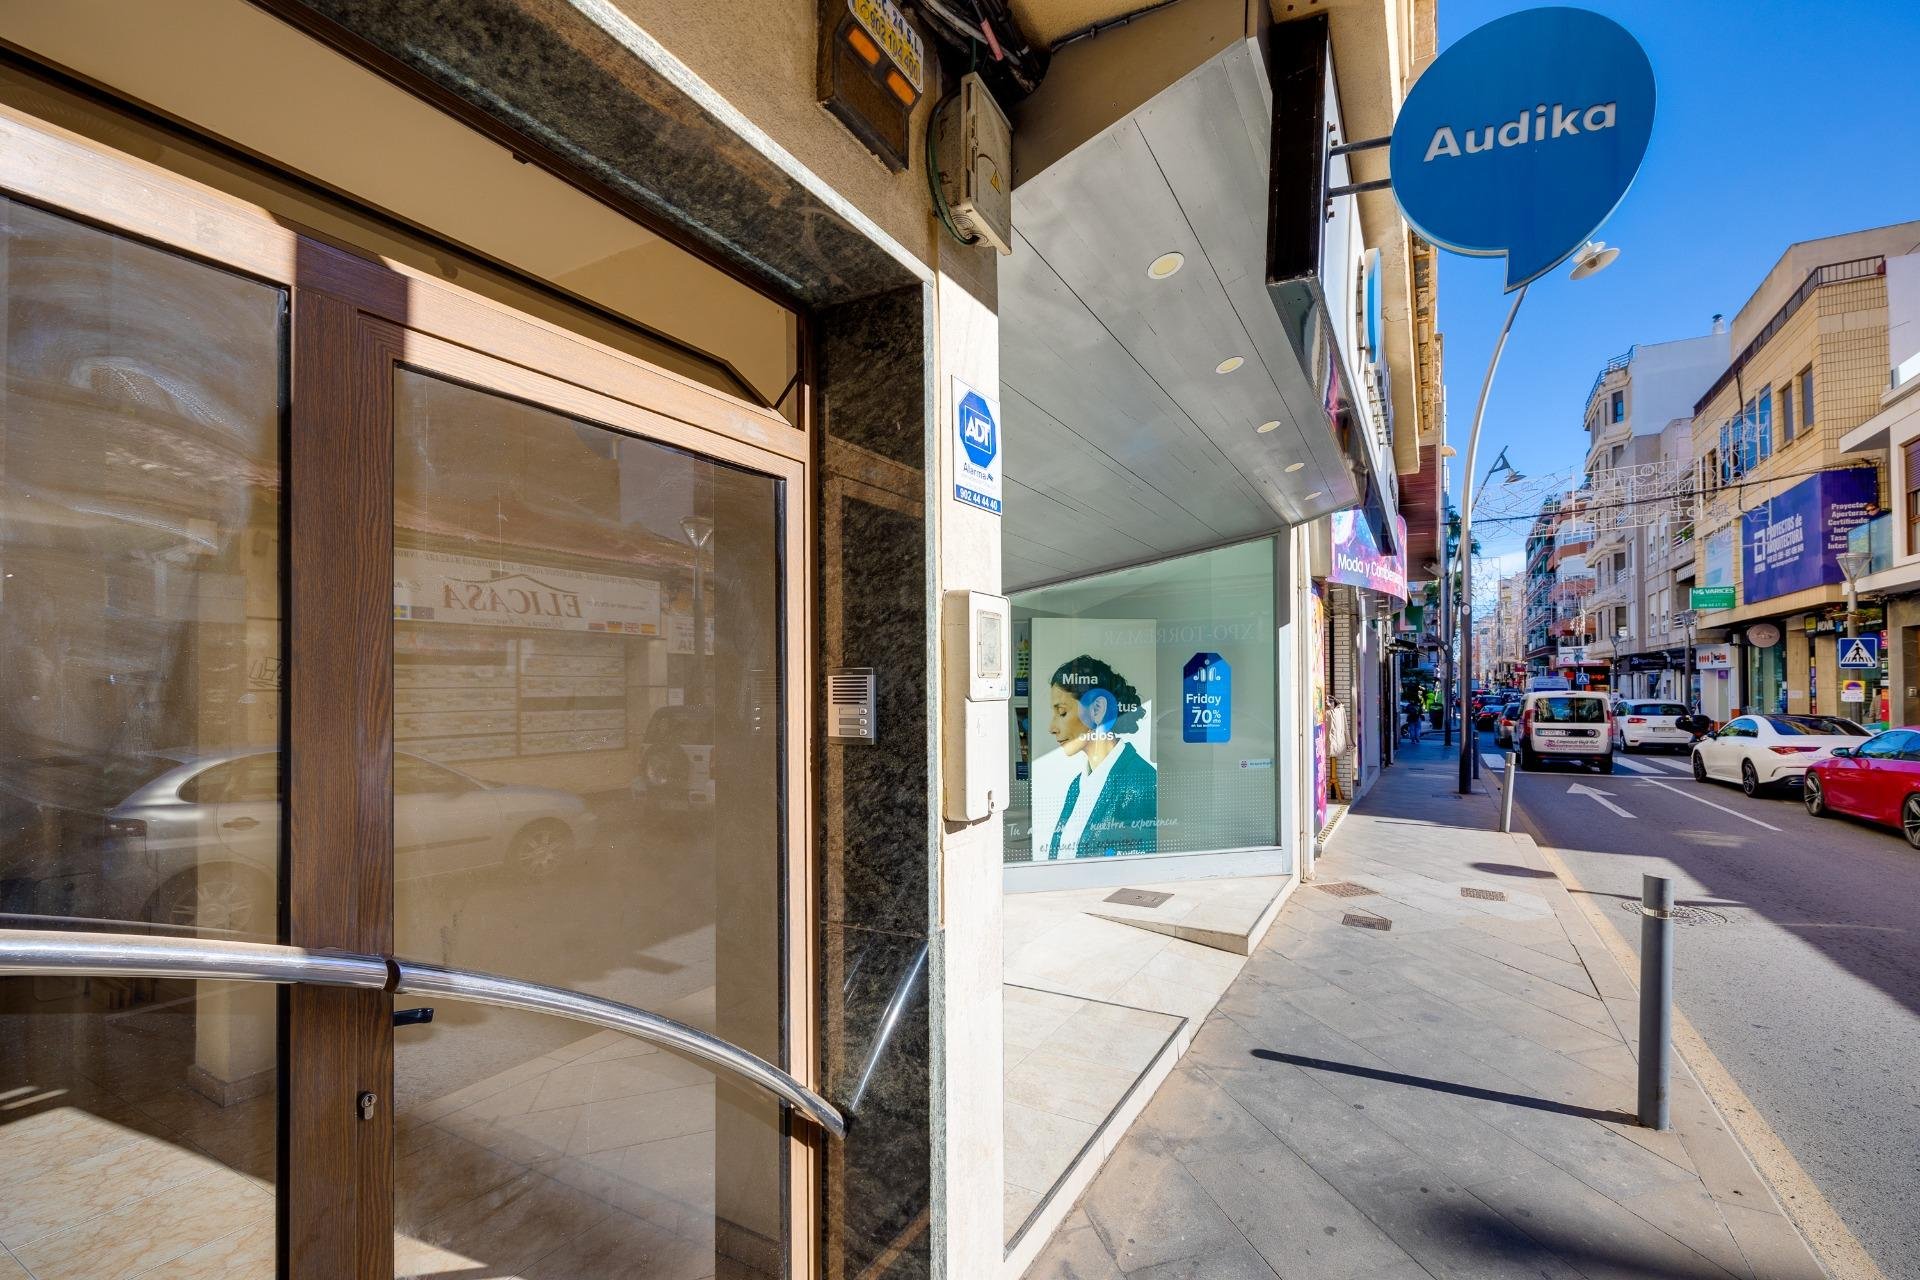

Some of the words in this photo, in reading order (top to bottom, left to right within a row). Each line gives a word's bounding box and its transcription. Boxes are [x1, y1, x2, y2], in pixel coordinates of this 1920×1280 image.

[1423, 101, 1617, 163] Audika
[966, 415, 991, 446] ADT
[959, 488, 972, 502] 902
[990, 499, 998, 511] 40
[1337, 553, 1363, 573] Moda
[1365, 561, 1371, 577] y
[1062, 673, 1098, 685] Mima
[1117, 702, 1138, 713] tus
[1186, 693, 1221, 706] Friday
[1080, 730, 1114, 741] oídos
[1007, 823, 1021, 837] Tu
[1131, 816, 1179, 835] experiencia
